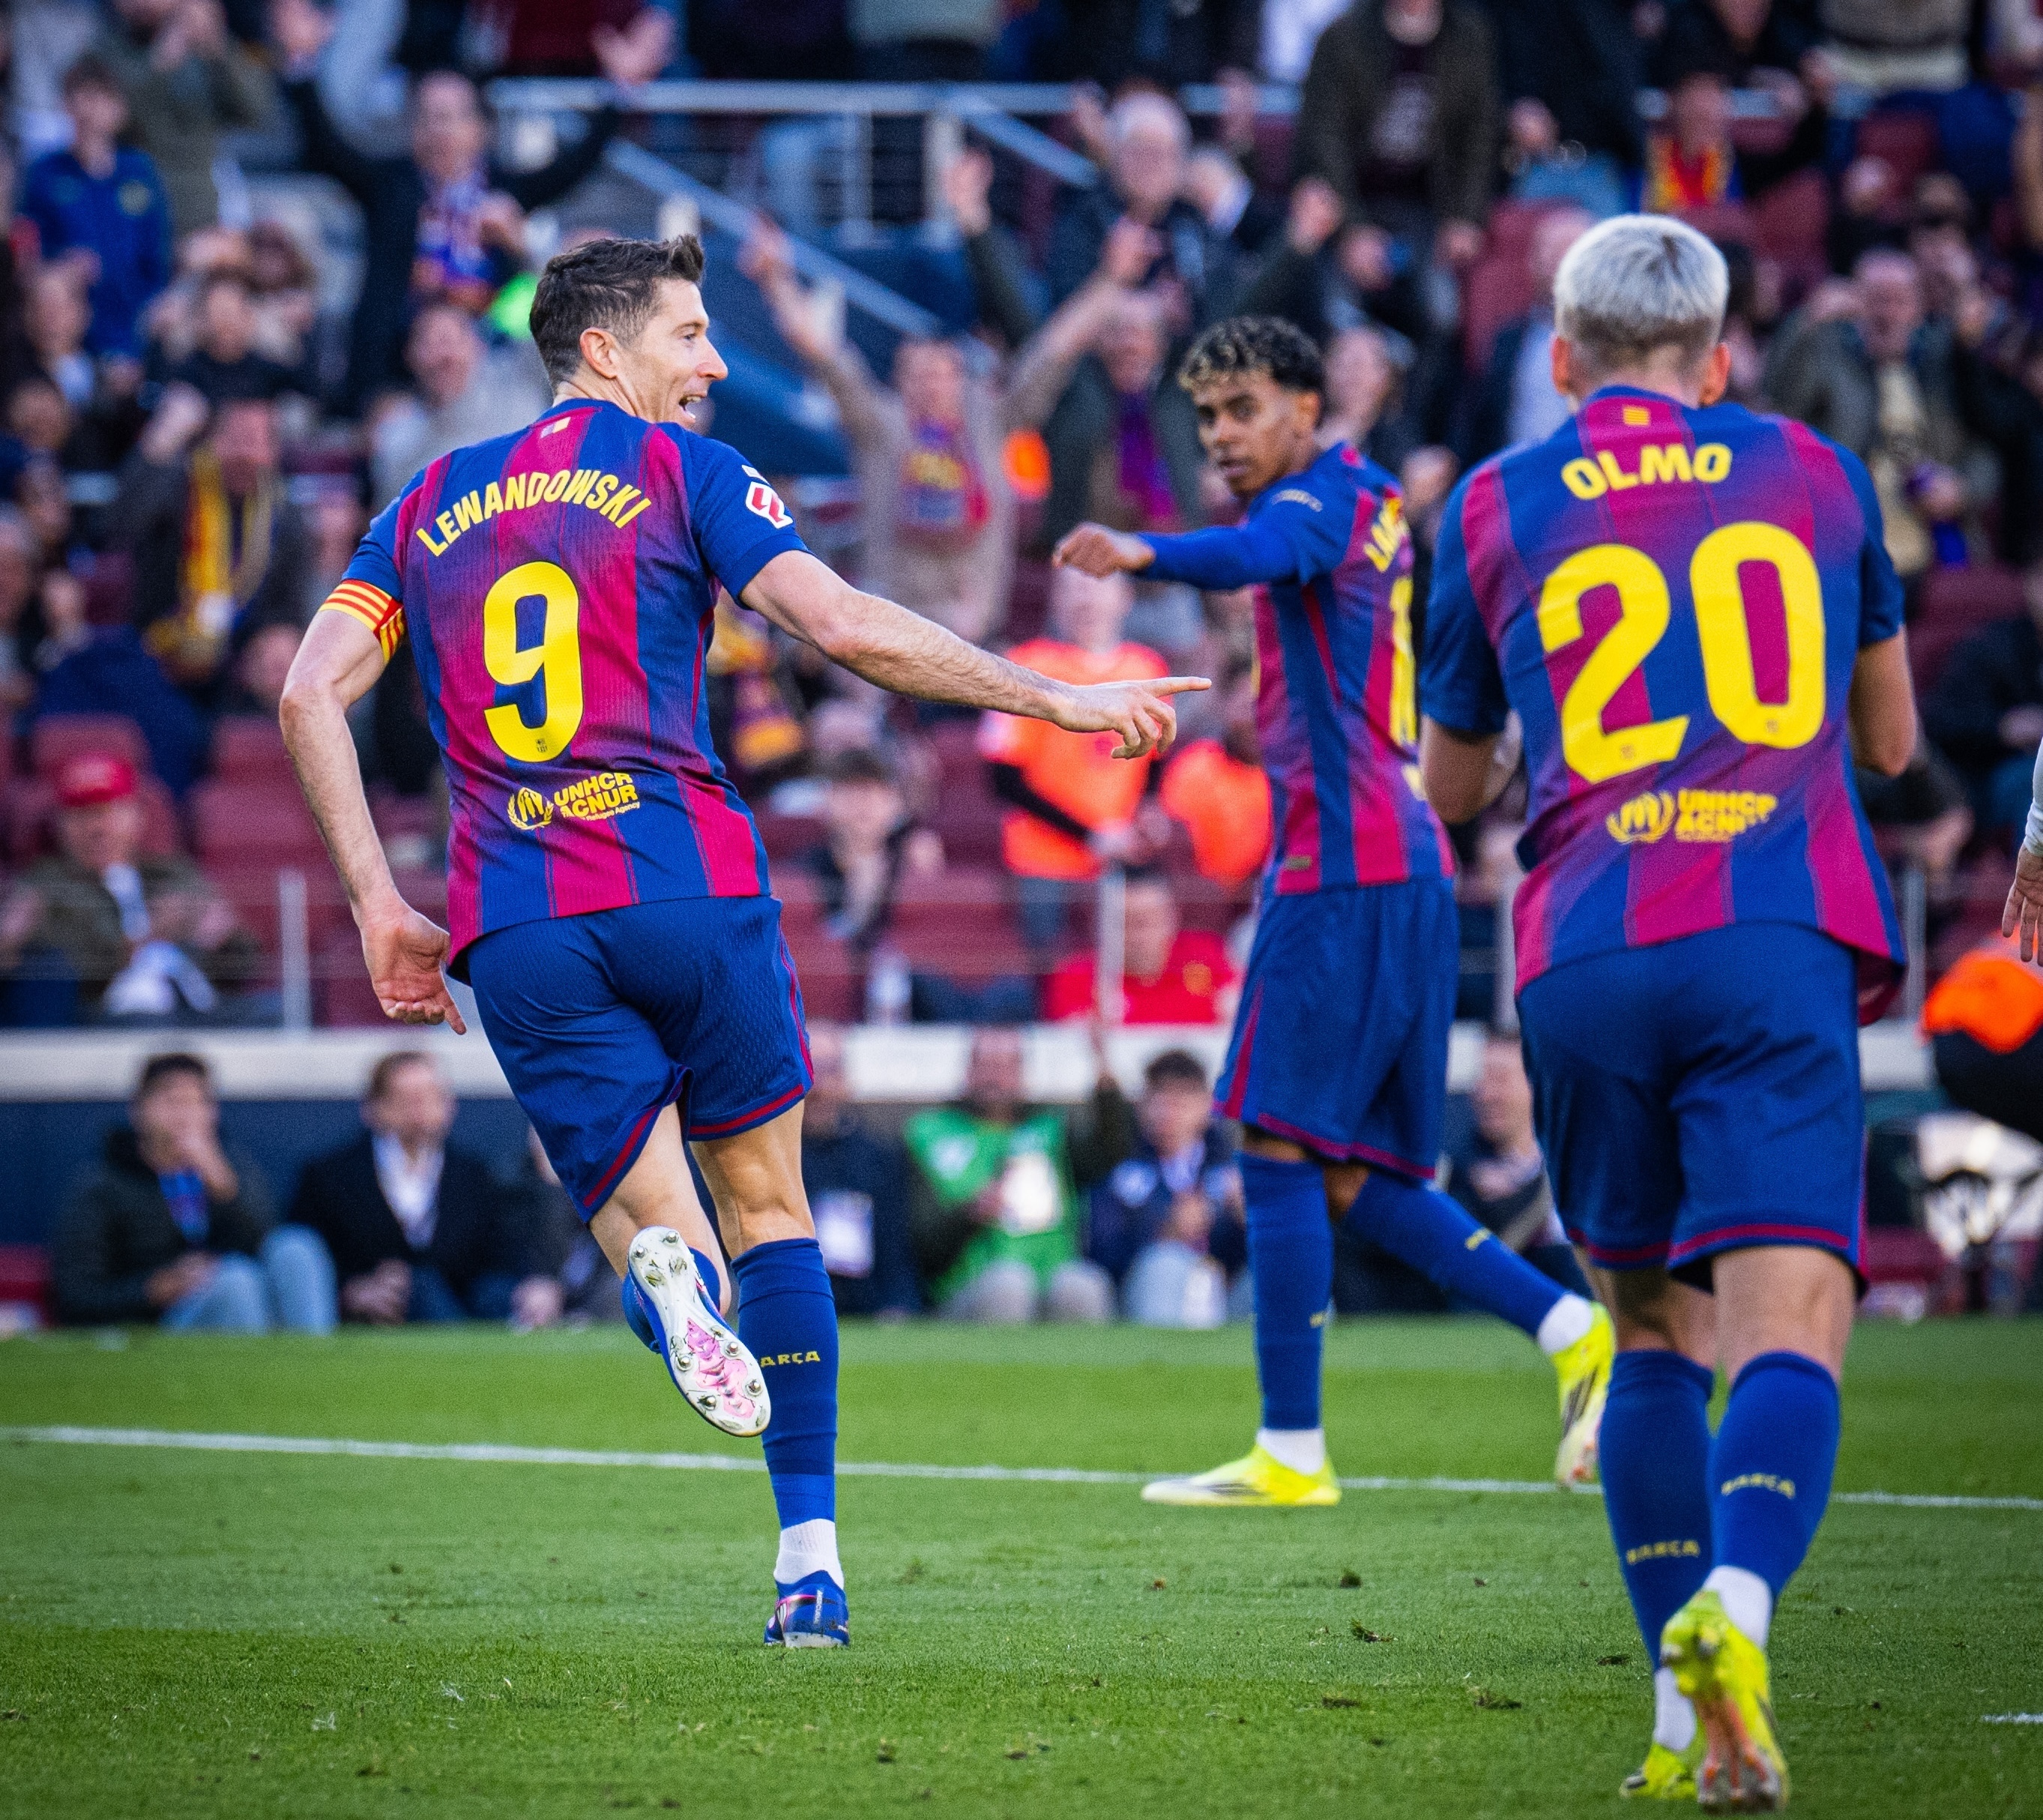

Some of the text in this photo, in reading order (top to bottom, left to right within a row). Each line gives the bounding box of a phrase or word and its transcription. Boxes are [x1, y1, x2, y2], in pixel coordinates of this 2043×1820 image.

[1561, 442, 1733, 500] OLMO
[416, 469, 651, 557] LEWANDOWSKI
[483, 561, 584, 762] 9
[1538, 521, 1827, 784] 20
[554, 772, 633, 807] UNHCR
[758, 1350, 821, 1368] ARÇA
